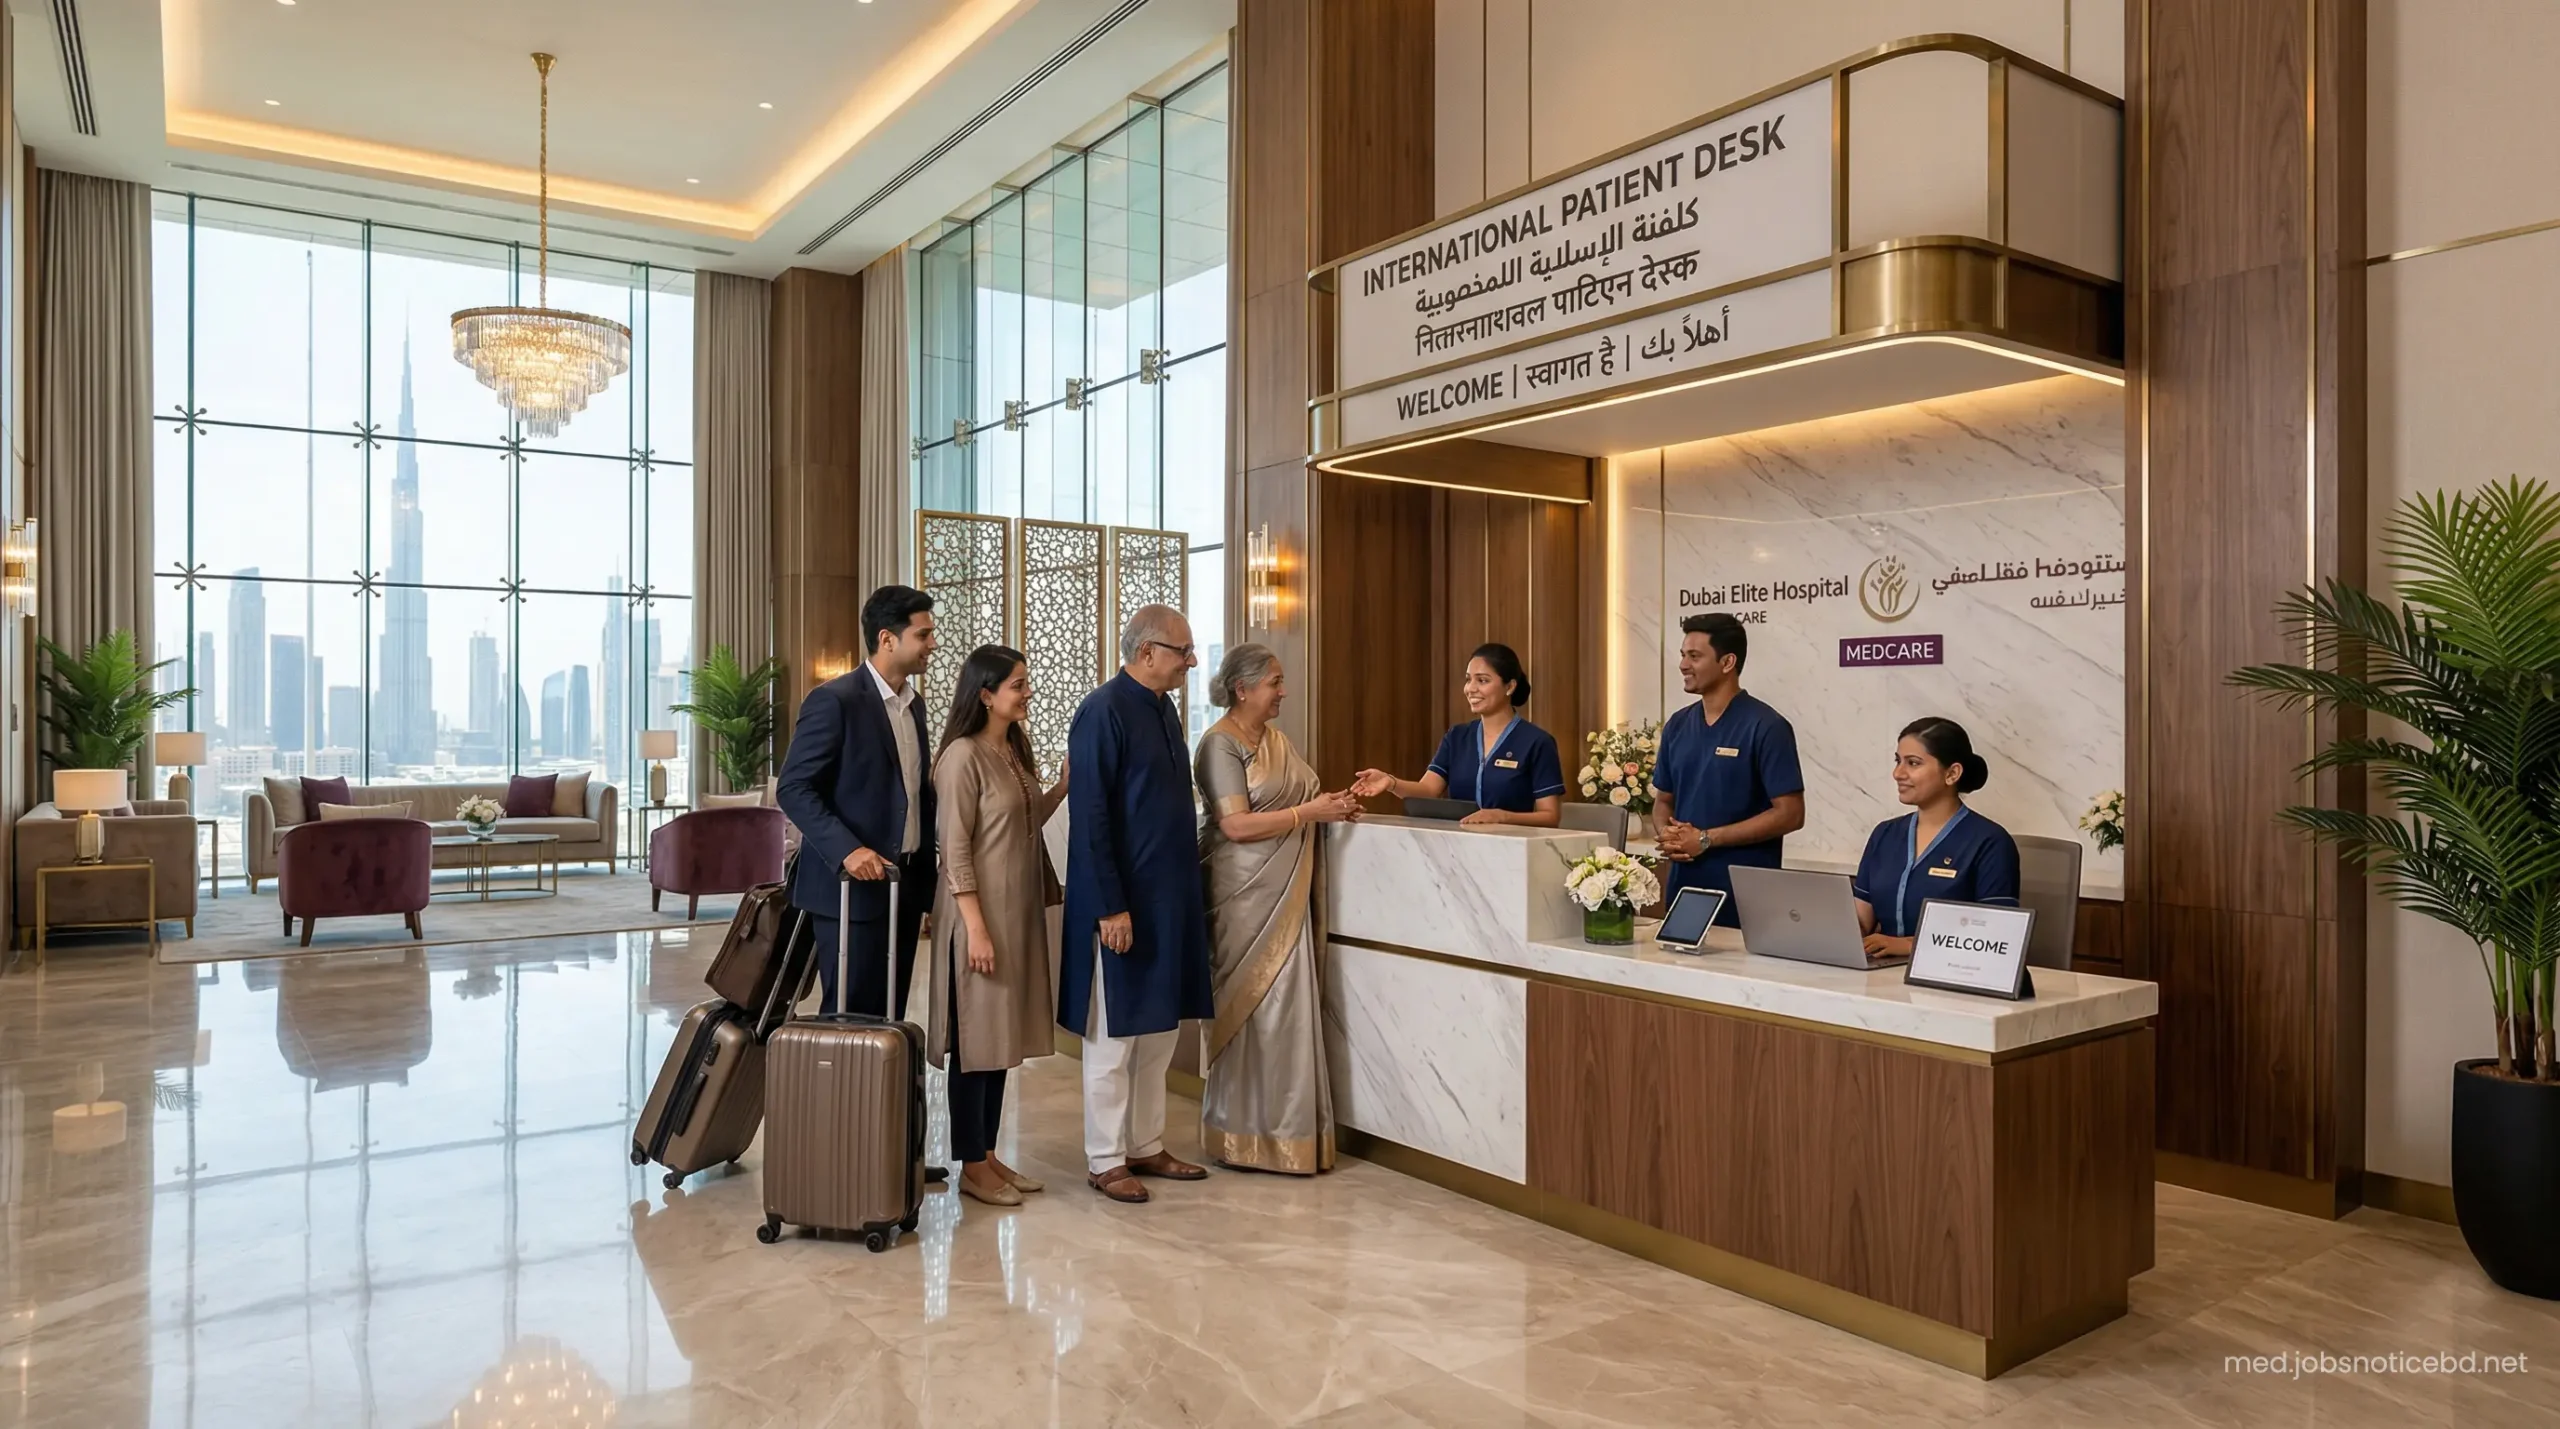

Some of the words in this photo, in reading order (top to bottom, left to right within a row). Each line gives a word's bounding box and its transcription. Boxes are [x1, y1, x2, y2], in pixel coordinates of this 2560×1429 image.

[1363, 204, 1553, 296] INTERNATIONAL
[1561, 152, 1684, 227] PATIENT
[1695, 115, 1786, 179] DESK
[1638, 249, 1700, 292] देस्क
[1397, 371, 1503, 421] WELCOME
[1525, 350, 1593, 390] स्वागत
[1599, 336, 1616, 376] है
[1641, 328, 1675, 362] بك
[1679, 586, 1726, 607] Dubai
[1731, 584, 1768, 603] Elite
[1773, 575, 1849, 604] Hospital
[1846, 643, 1934, 661] MEDCARE
[1932, 933, 2008, 955] WELCOME
